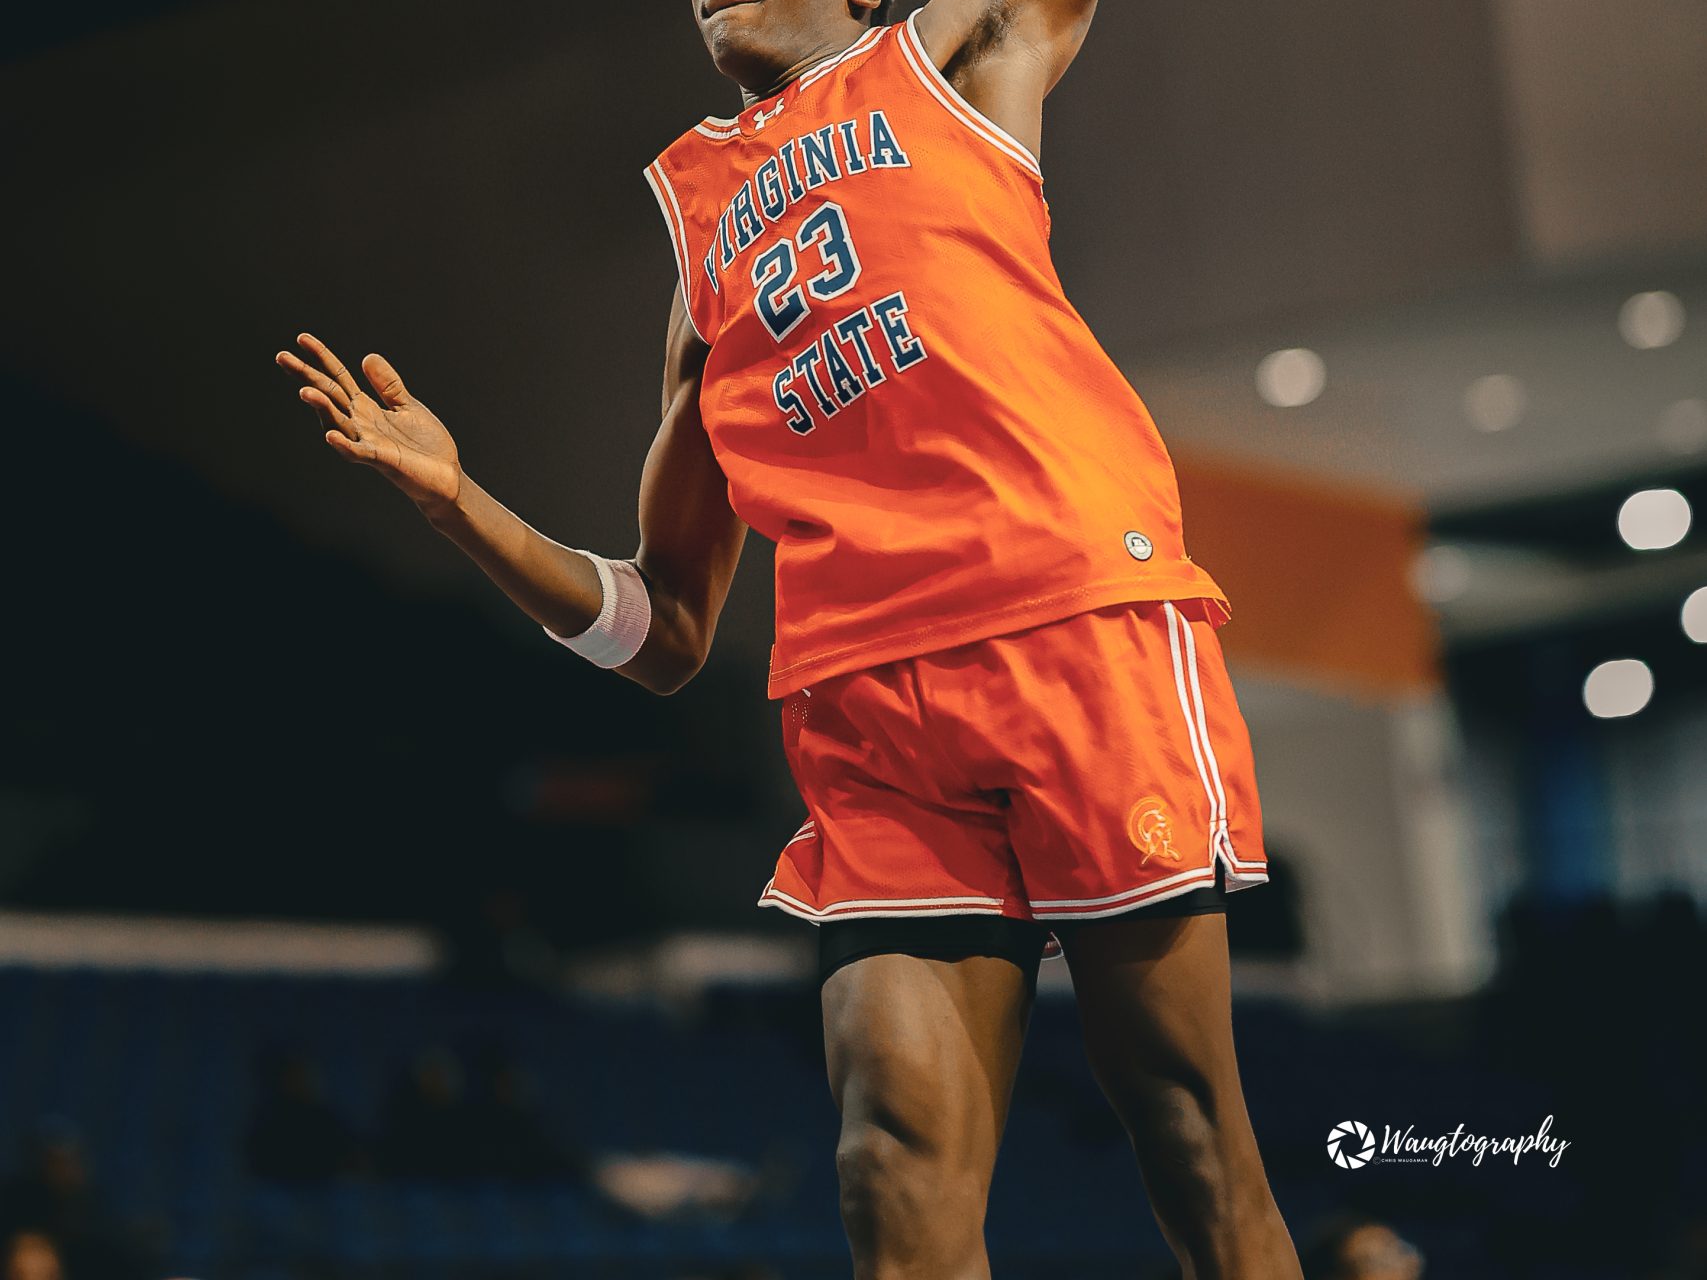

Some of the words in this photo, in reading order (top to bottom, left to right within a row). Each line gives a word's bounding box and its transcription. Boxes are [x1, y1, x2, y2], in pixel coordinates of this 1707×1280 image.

[703, 110, 911, 295] VIRGINIA
[751, 201, 862, 343] 23
[772, 291, 928, 436] STATE
